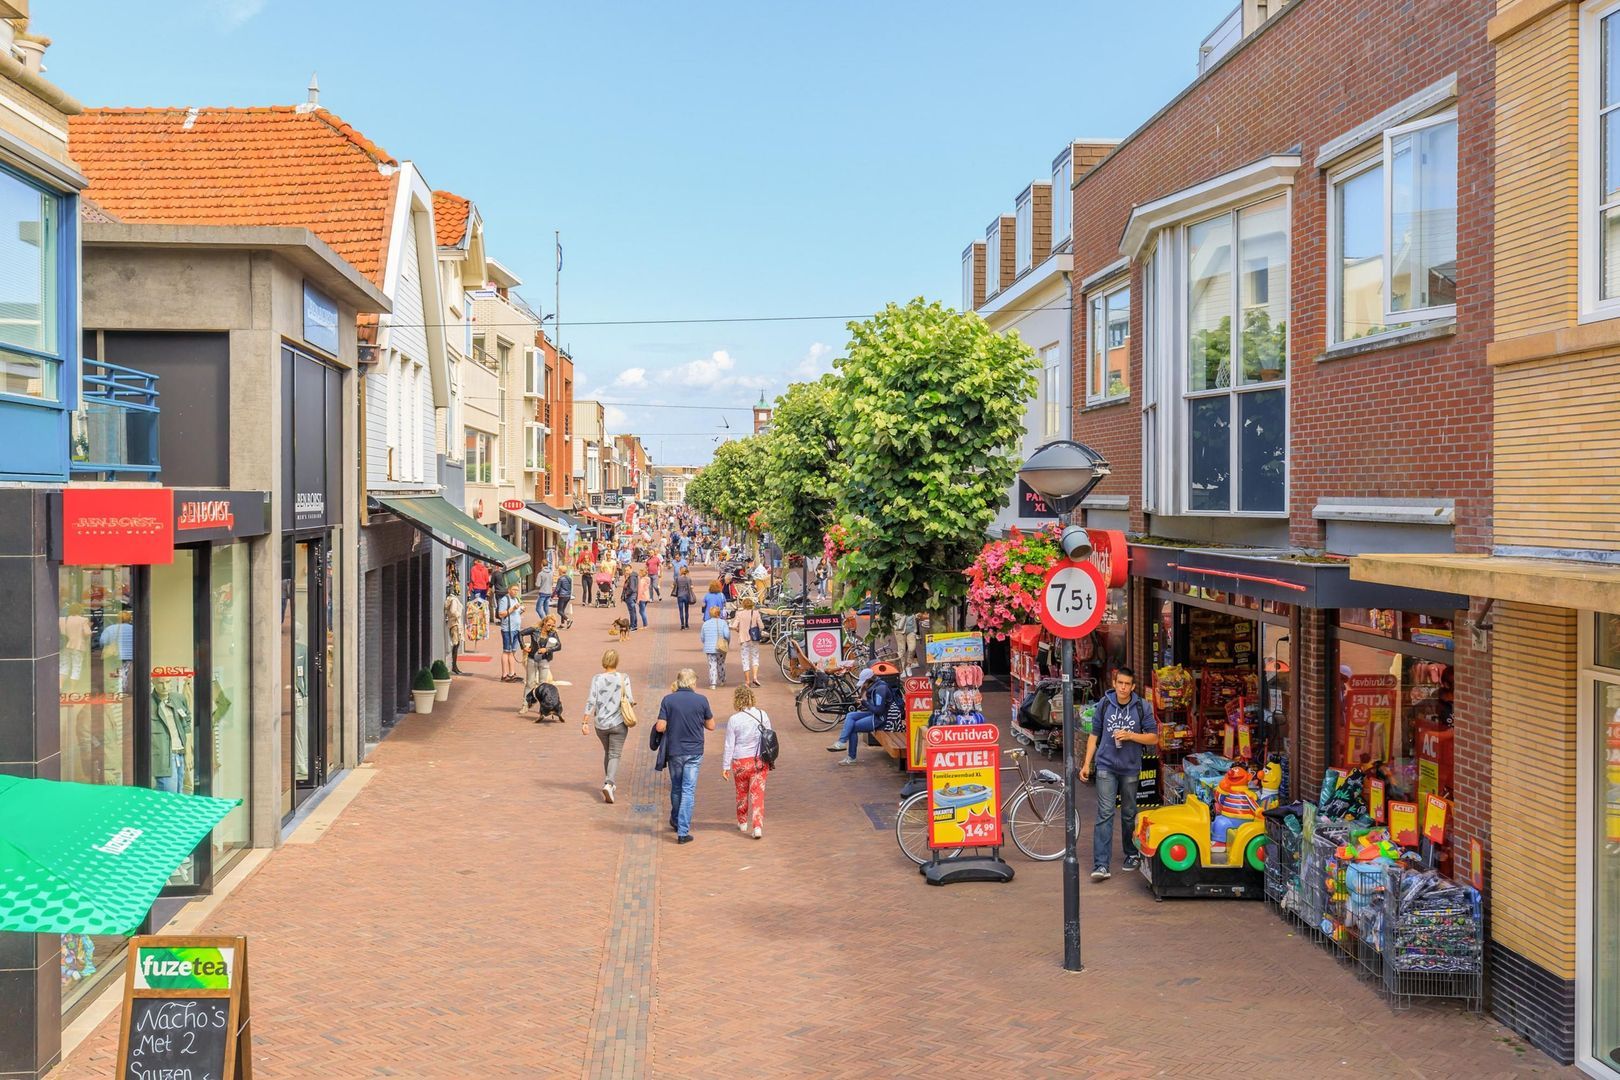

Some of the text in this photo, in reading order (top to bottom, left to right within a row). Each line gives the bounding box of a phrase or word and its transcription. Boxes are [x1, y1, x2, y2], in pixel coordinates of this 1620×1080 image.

[1034, 503, 1047, 512] XL
[76, 516, 157, 528] BEN BORST
[152, 666, 188, 675] ORST
[944, 728, 994, 742] Kruidvat
[933, 750, 989, 768] ACTIE!
[1392, 804, 1415, 813] ACTIE!
[964, 823, 994, 838] 14.99
[143, 955, 228, 976] fuzetea
[136, 1001, 226, 1032] Nacho's
[132, 1031, 198, 1056] Met 2
